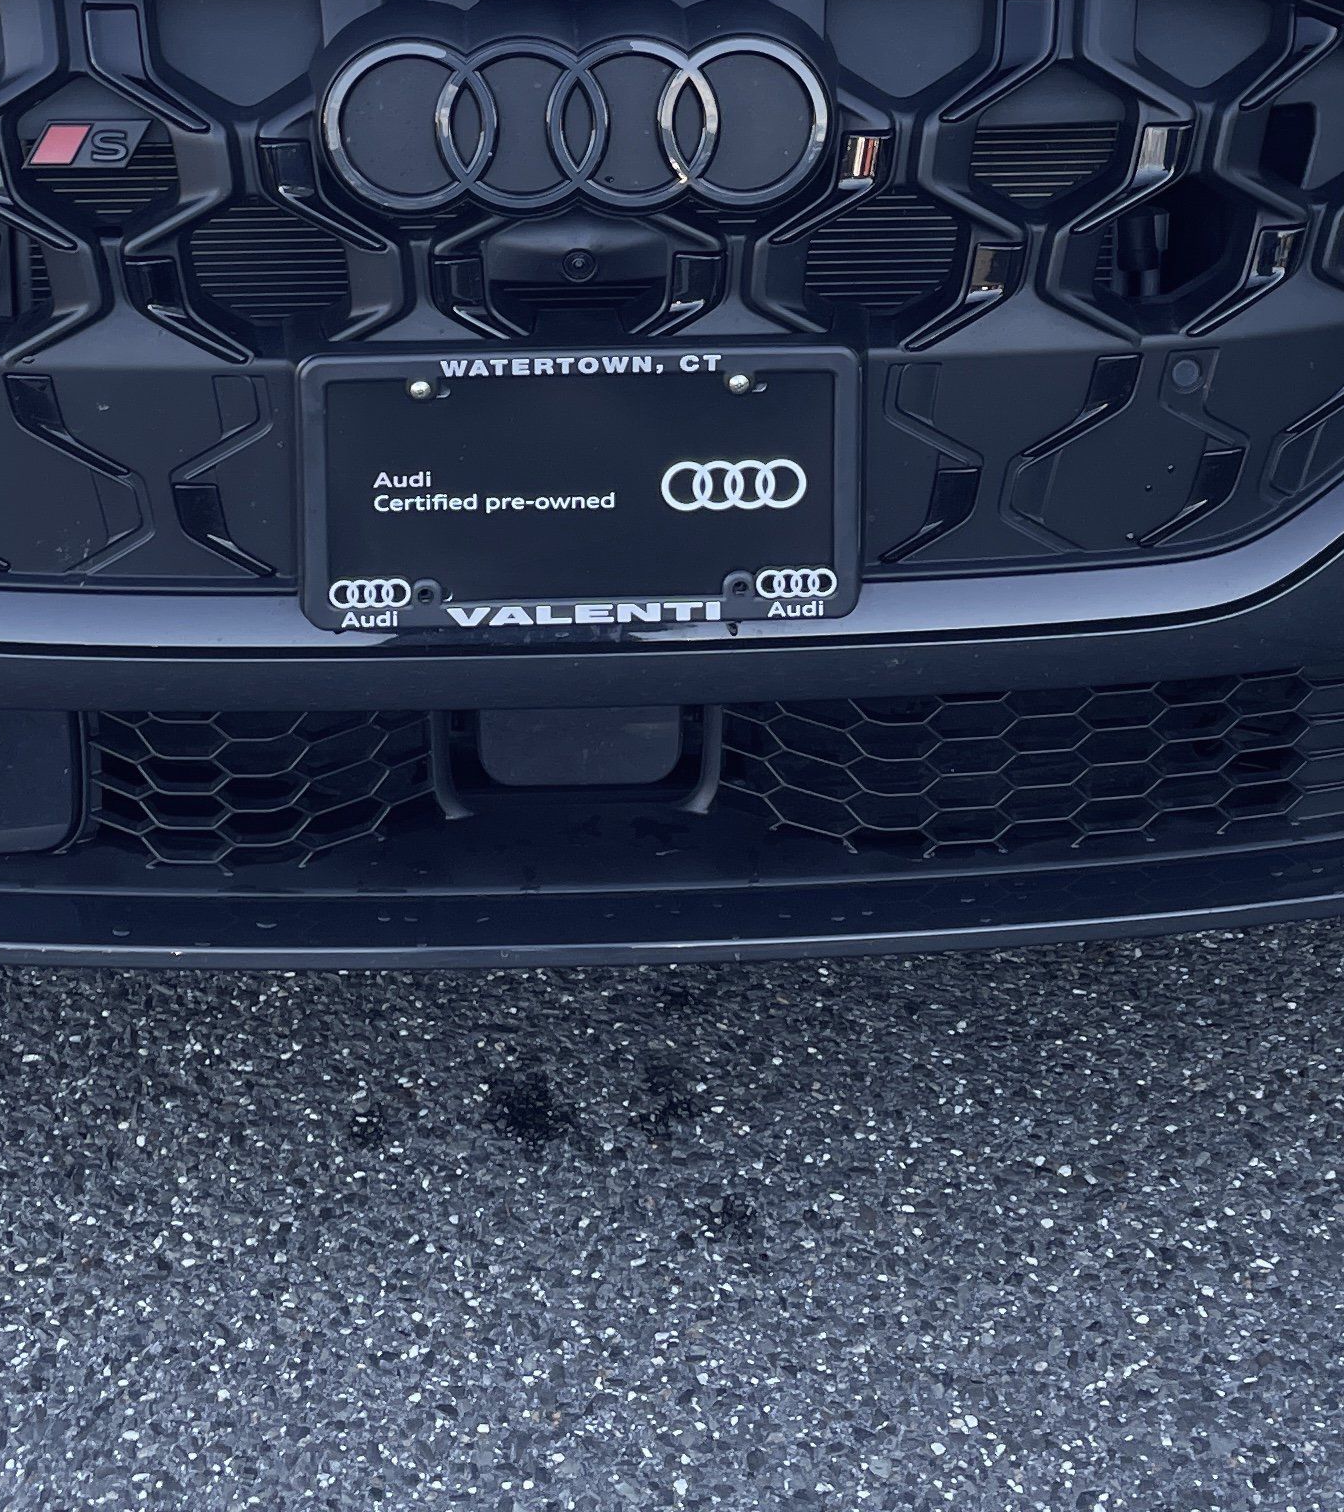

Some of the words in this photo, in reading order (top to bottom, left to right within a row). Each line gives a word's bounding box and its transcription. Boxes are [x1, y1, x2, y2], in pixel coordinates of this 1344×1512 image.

[440, 355, 664, 378] WATERTOWN,
[679, 353, 722, 373] CT
[373, 470, 432, 489] Audi
[373, 493, 478, 512] Certified
[485, 491, 616, 514] pre-owned
[341, 609, 399, 629] Audi
[446, 600, 722, 627] VALENTI
[767, 599, 825, 619] Audi
